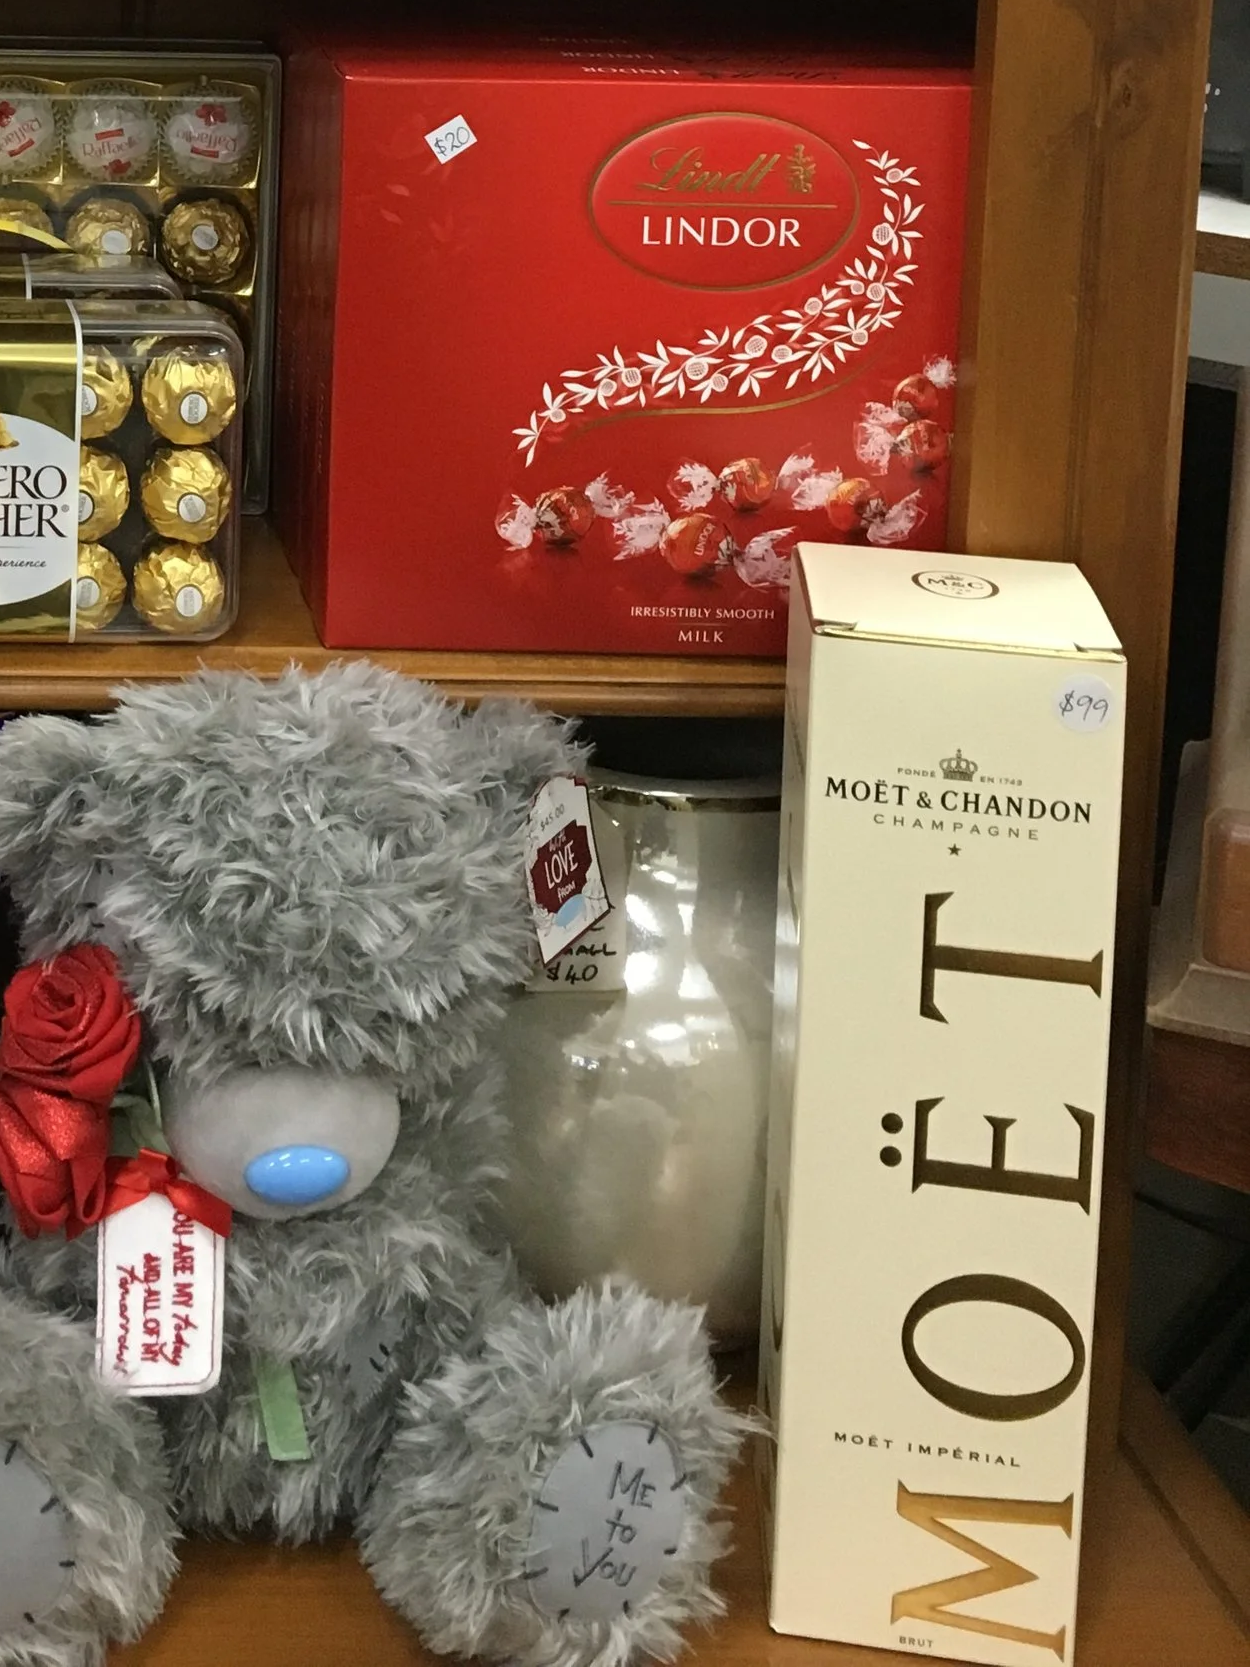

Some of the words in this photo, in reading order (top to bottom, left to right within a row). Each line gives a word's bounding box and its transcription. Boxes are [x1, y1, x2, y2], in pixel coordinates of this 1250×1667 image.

[433, 126, 471, 157] $20
[642, 147, 780, 192] Lindt
[641, 215, 801, 248] LINDOR
[631, 606, 711, 618] IRRESISTIBLY
[716, 608, 775, 620] SMOOTH
[678, 630, 724, 643] MILK
[1059, 690, 1109, 722] $99
[979, 776, 996, 785] EN
[825, 776, 910, 807] MOËT
[916, 791, 933, 810] &
[940, 789, 1092, 824] CHANDON
[873, 813, 1039, 840] CHAMPAGNE
[544, 839, 579, 890] LOVE
[172, 1242, 195, 1277] ARE
[880, 891, 1104, 1663] MOËT
[171, 1282, 194, 1309] MY
[908, 1442, 1021, 1468] IMPÉRIAL
[609, 1460, 656, 1509] ME
[899, 1634, 935, 1649] BRUT
